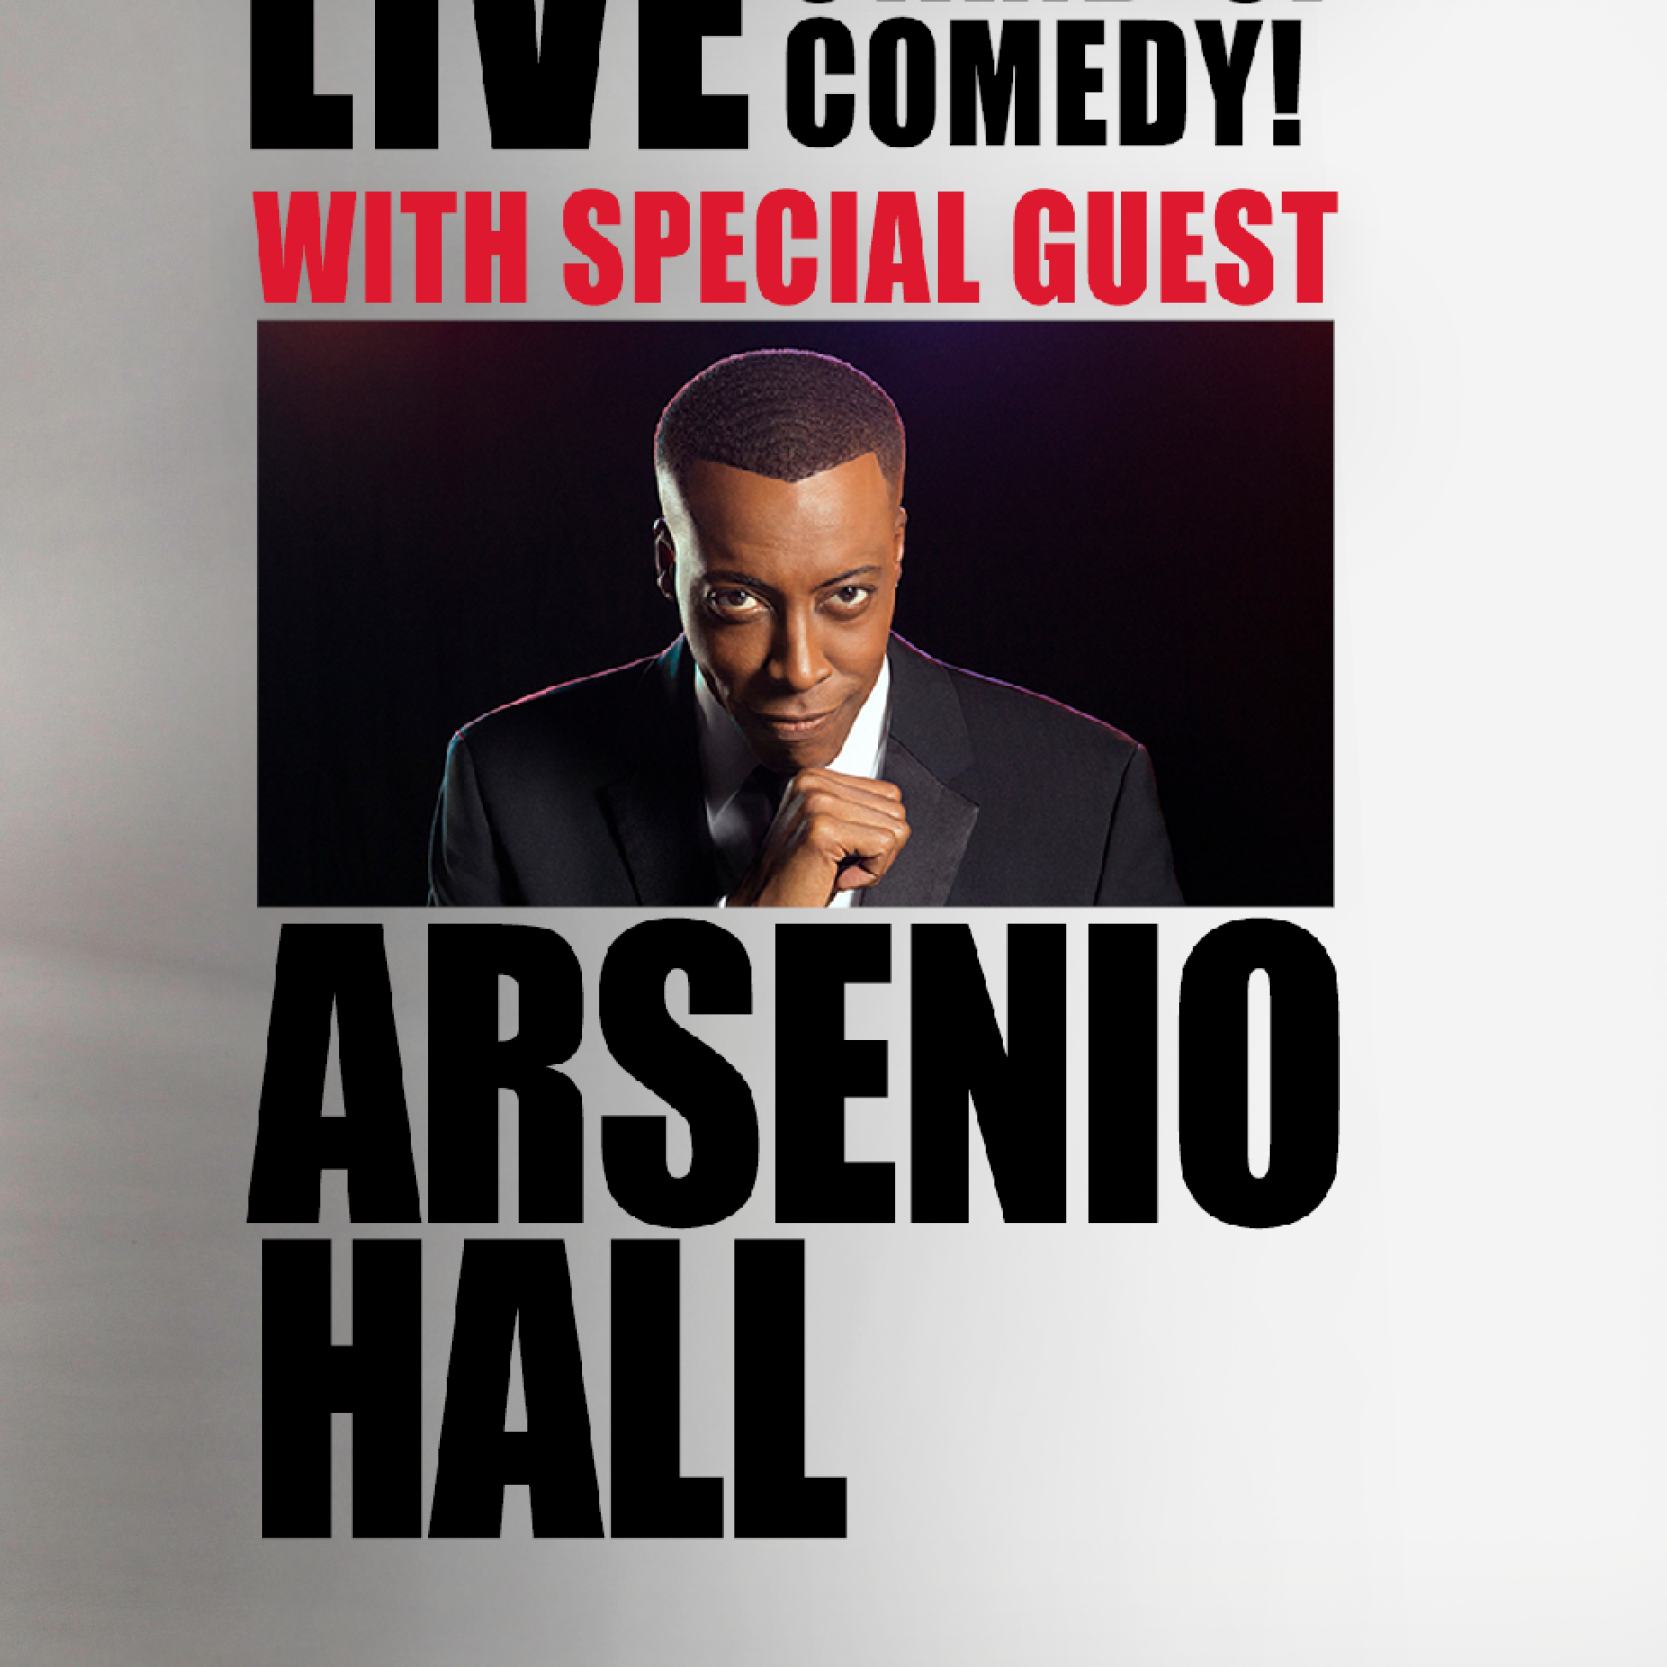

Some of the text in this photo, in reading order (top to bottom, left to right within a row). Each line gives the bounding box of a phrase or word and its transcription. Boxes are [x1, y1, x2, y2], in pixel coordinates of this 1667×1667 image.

[787, 17, 1301, 147] COMEDY!
[252, 188, 1338, 306] WITH SPECIAL GUEST
[247, 919, 1339, 1228] ARSENIO
[262, 1239, 846, 1538] HALL
